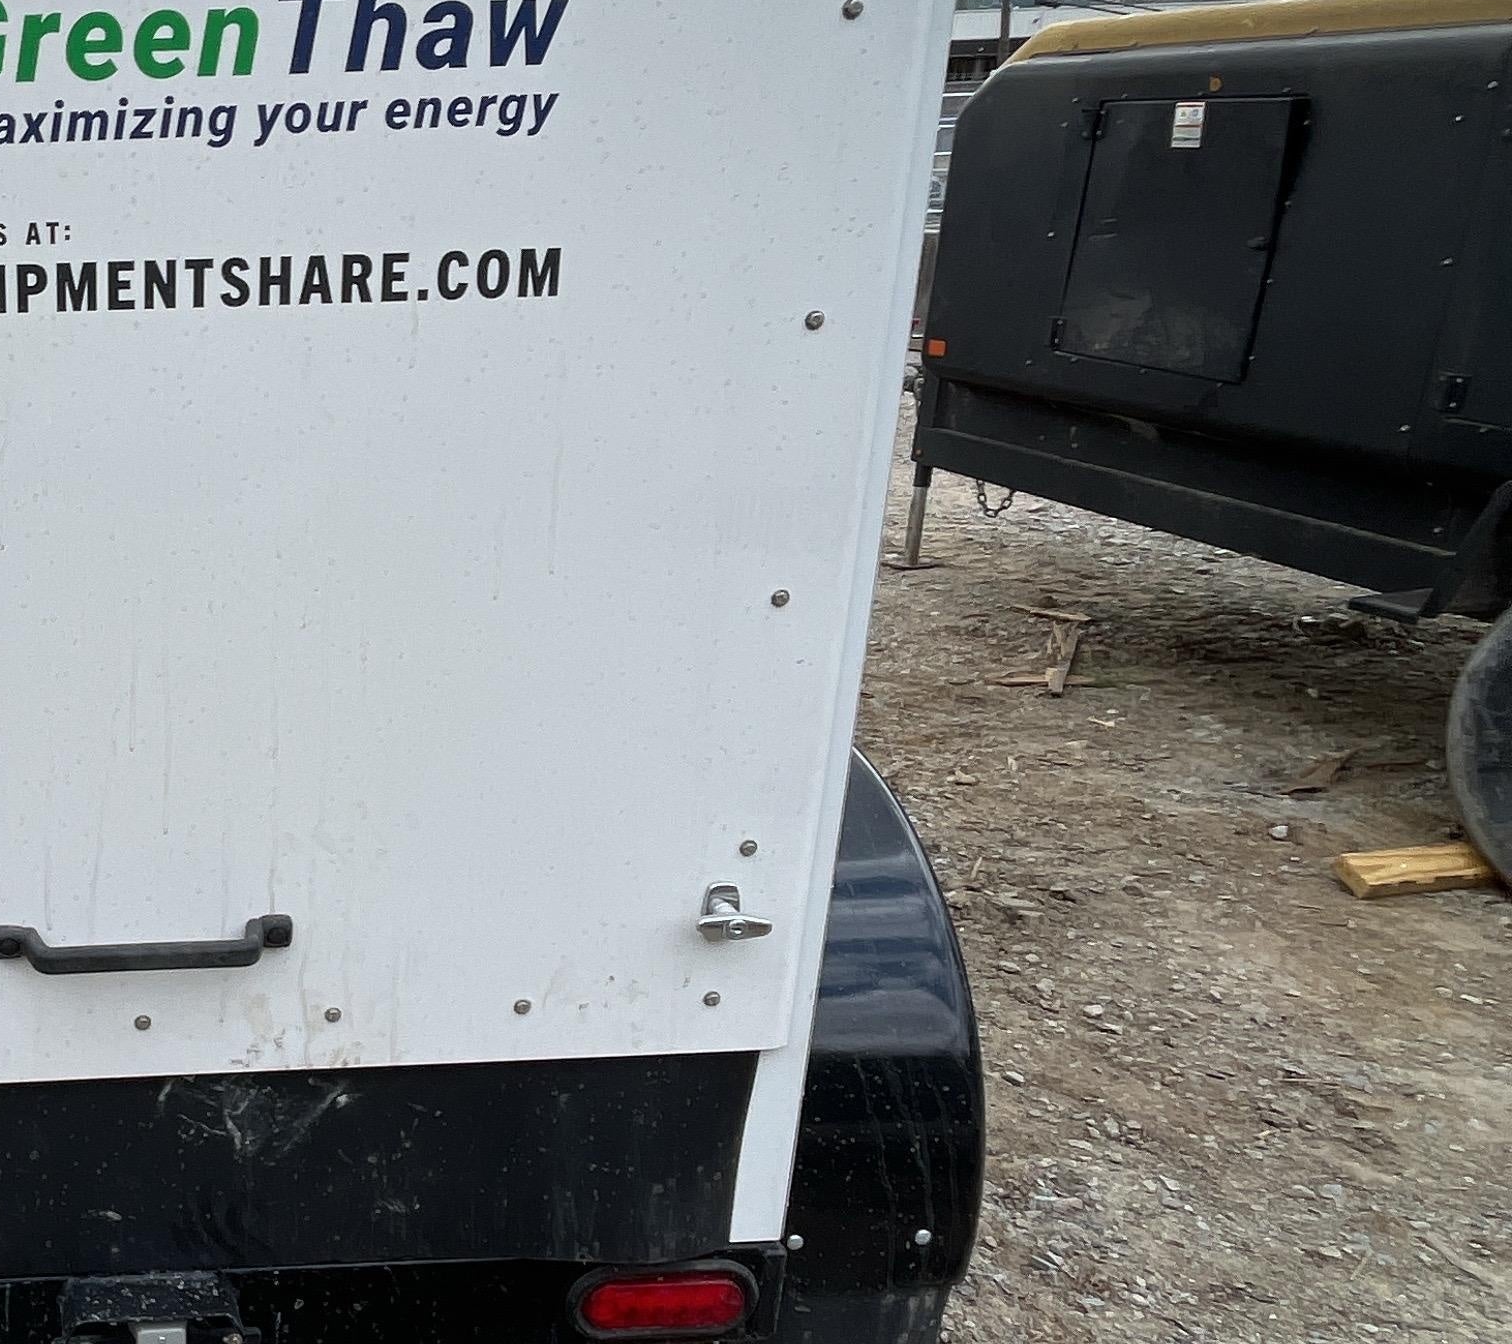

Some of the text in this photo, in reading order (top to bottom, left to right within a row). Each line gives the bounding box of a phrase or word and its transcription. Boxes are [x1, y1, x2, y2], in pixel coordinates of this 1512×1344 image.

[254, 99, 369, 146] your
[385, 91, 561, 138] energy
[25, 221, 73, 246] AT:
